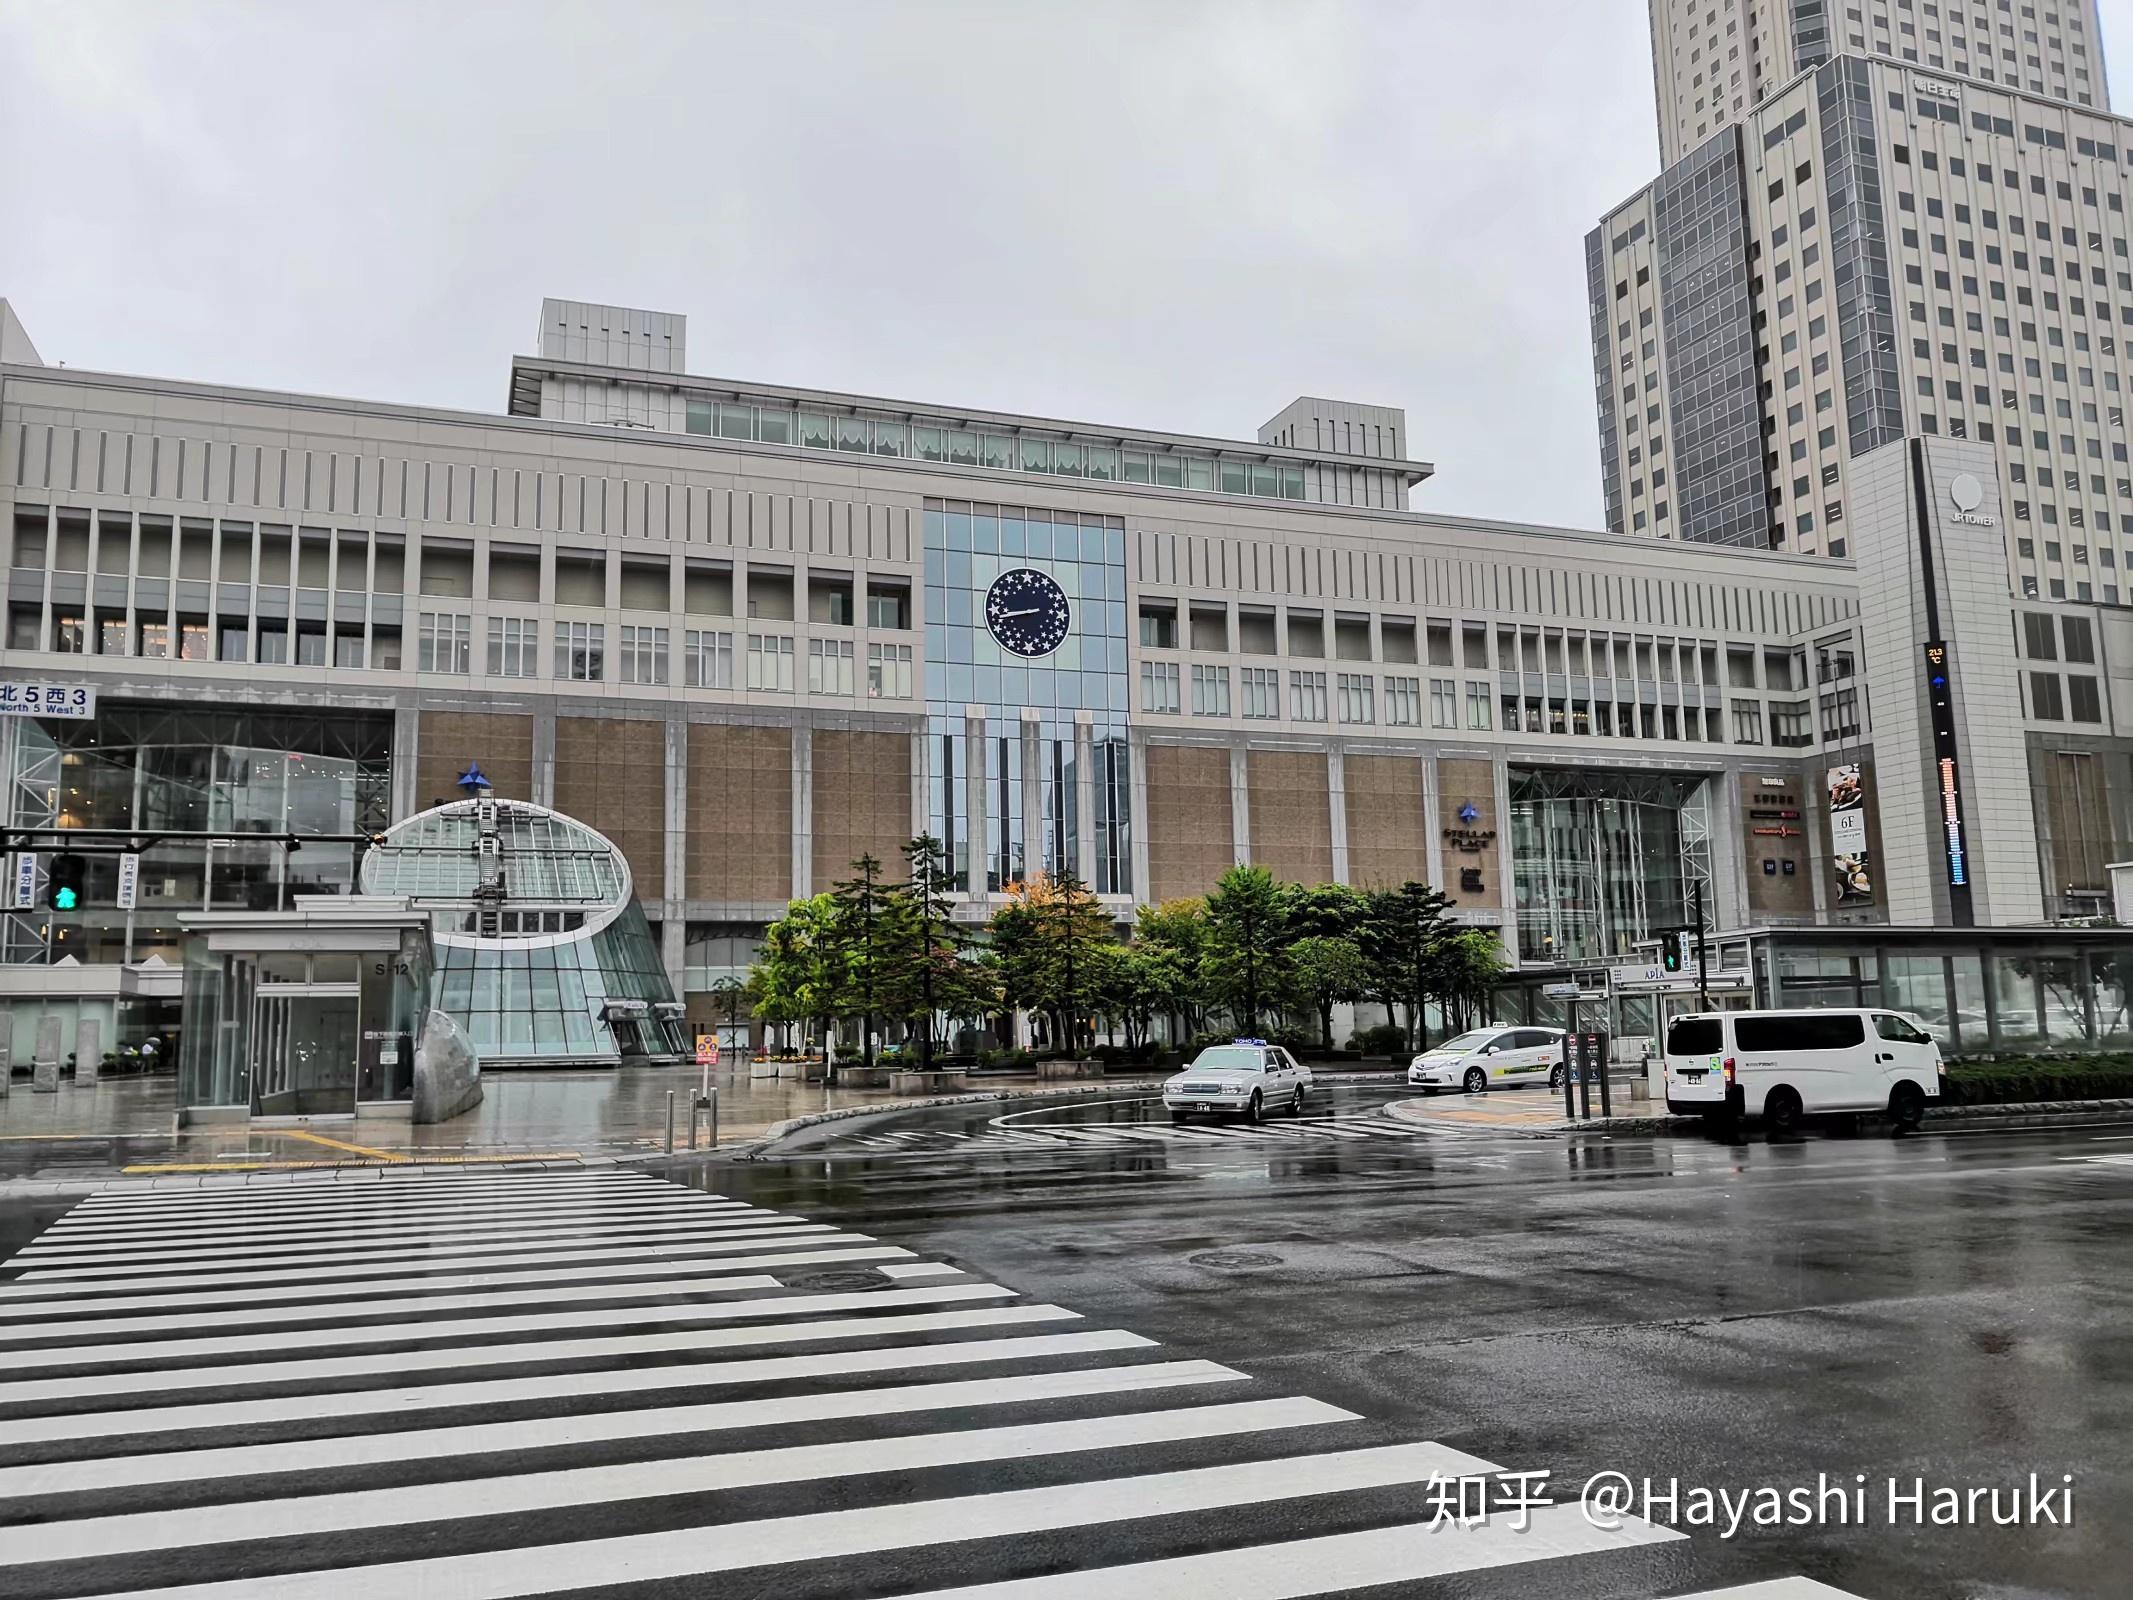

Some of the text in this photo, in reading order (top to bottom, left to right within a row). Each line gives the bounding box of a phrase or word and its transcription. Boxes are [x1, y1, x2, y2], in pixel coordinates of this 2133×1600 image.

[33, 703, 40, 712] 5
[46, 704, 74, 714] West
[79, 707, 85, 715] 3
[1841, 815, 1855, 829] 6F
[1451, 839, 1489, 848] PLACE
[1644, 967, 1665, 980] APIA
